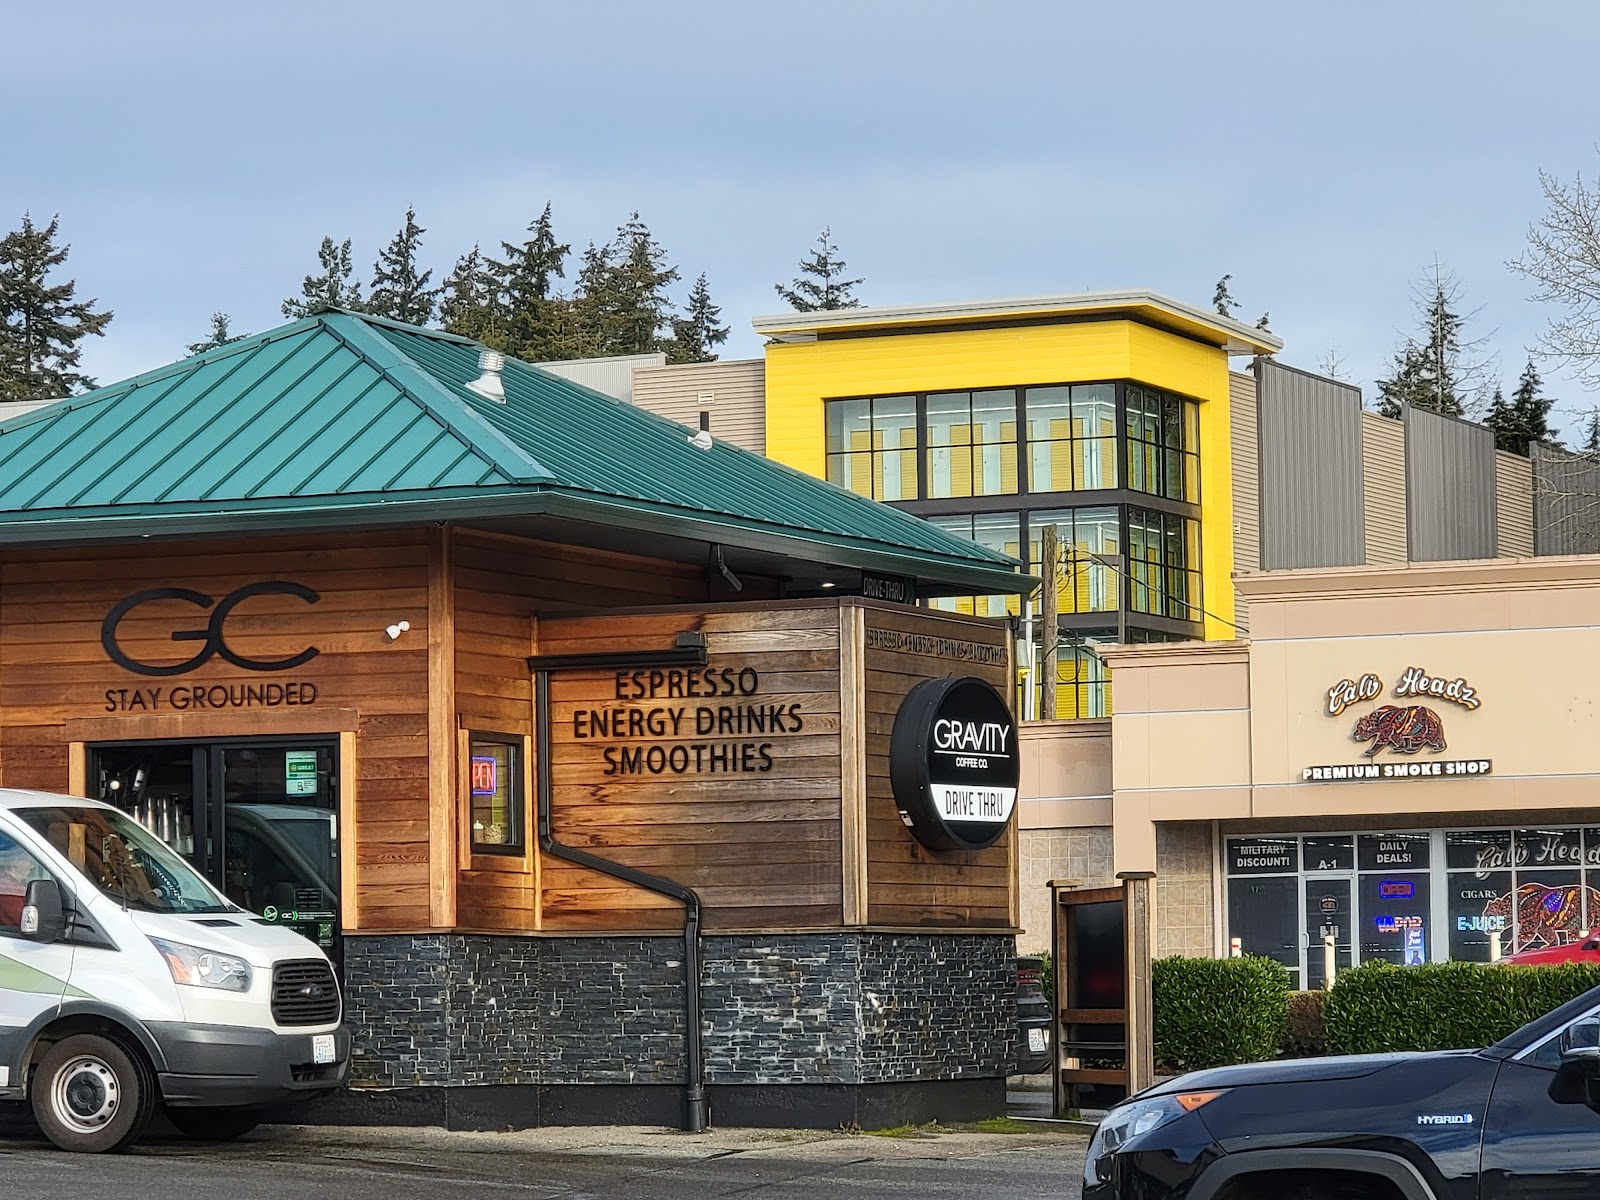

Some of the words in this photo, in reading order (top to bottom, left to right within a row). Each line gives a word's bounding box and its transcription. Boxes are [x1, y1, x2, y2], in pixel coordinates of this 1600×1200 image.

[863, 577, 904, 600] DRIVE-THRU
[101, 581, 321, 677] GC
[615, 667, 758, 699] ESPRESSO
[1328, 674, 1382, 715] Cali
[1396, 667, 1481, 709] Headz
[105, 687, 161, 712] STAY
[170, 682, 319, 710] GROUNDED
[573, 707, 685, 739] ENERGY
[696, 703, 803, 735] DRINKS
[934, 719, 1010, 752] GRAVITY
[603, 743, 773, 775] SMOOTHIES
[955, 757, 978, 768] COFFEE
[978, 759, 988, 769] CO.
[472, 762, 494, 789] PEN
[1302, 765, 1380, 780] PREMIUM
[1383, 763, 1441, 778] SMOKE
[1445, 761, 1490, 775] SHOP
[945, 791, 975, 816] DRIVE
[977, 792, 1003, 817] THRU
[1240, 845, 1286, 856] MILITARY
[1379, 841, 1408, 852] DAILY
[1236, 857, 1290, 868] DISCOUNT!
[1318, 859, 1338, 870] A-1
[1376, 853, 1412, 864] DEALS!
[1460, 889, 1497, 899] CIGARS
[1457, 916, 1505, 931] E-JUICE
[1417, 1116, 1464, 1125] HYBRID
